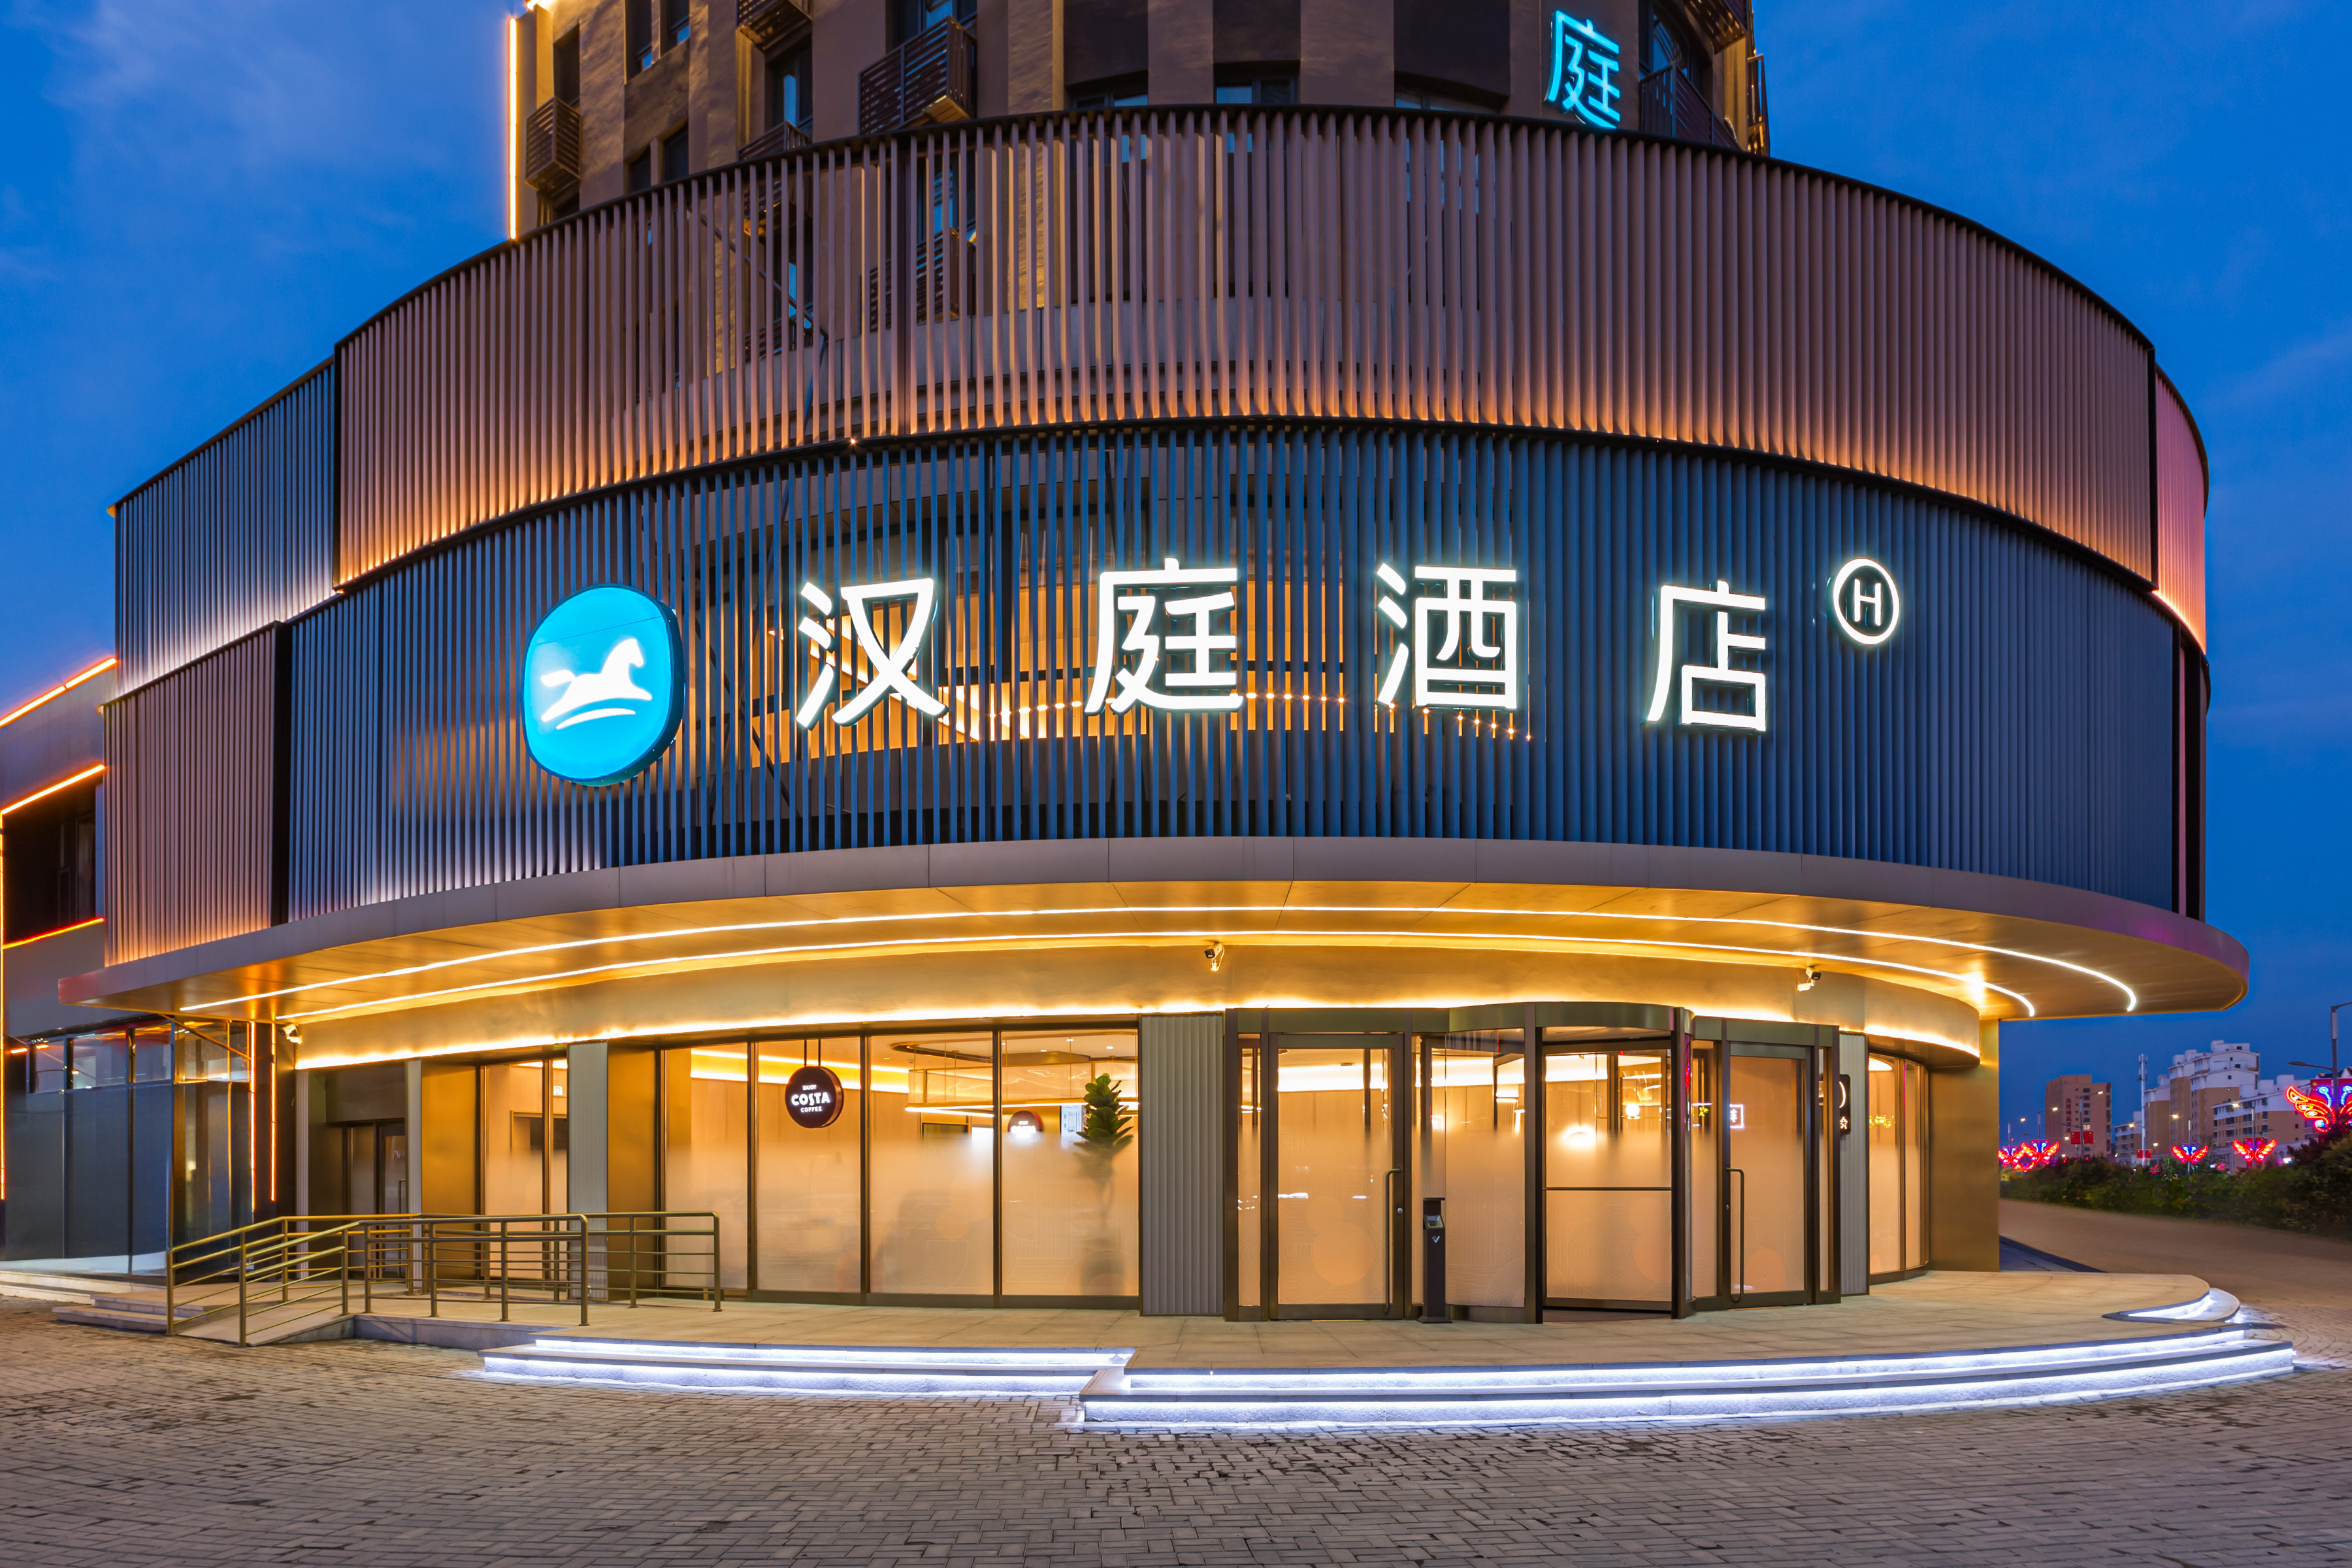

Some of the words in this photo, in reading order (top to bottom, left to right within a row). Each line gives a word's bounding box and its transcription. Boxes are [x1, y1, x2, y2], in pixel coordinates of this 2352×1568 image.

[1546, 10, 1621, 129] 庭
[795, 557, 1767, 732] 汉庭酒店
[791, 1092, 830, 1106] COSTA
